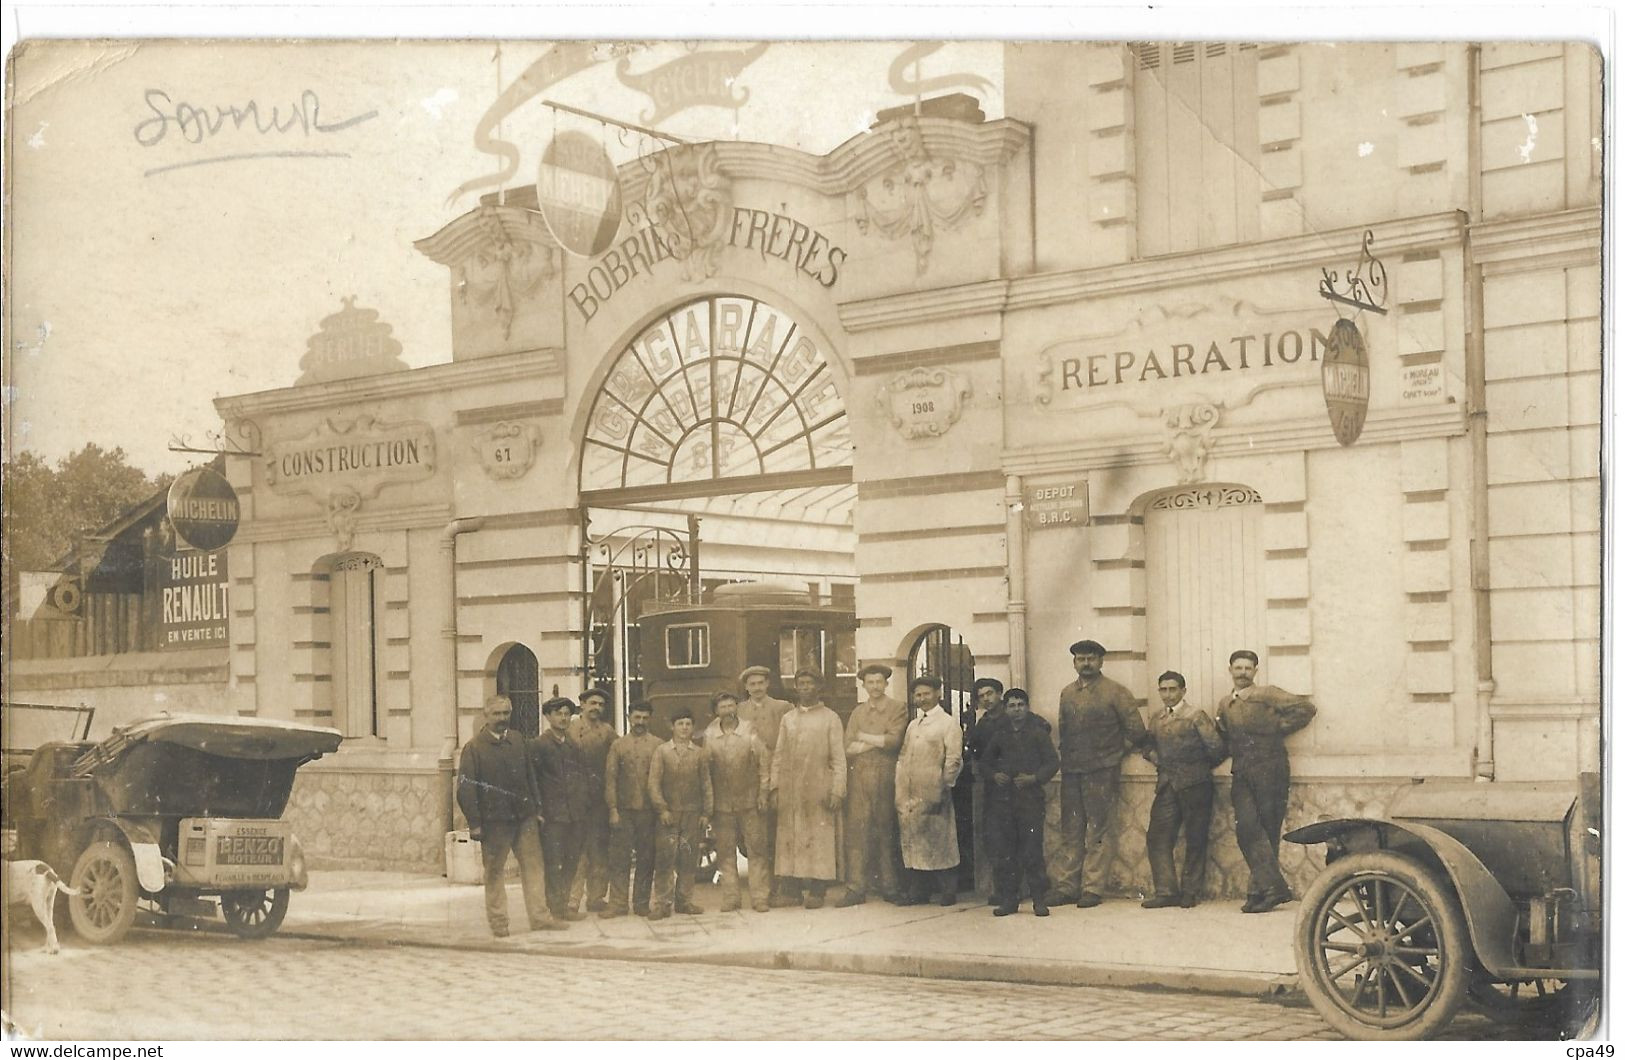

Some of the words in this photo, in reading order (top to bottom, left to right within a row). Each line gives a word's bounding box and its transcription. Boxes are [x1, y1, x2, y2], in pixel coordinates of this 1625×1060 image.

[642, 302, 842, 421] GARAGE
[639, 373, 777, 459] MODERNE
[911, 401, 935, 415] 1908
[282, 438, 420, 477] CONSTRUCTION
[495, 448, 512, 463] 67
[1036, 485, 1075, 500] DEPOT
[172, 498, 238, 521] MICHELIN
[171, 554, 218, 581] HUILE
[163, 582, 229, 624] RENAULT
[168, 631, 179, 643] EN
[181, 628, 212, 641] VENTE
[214, 626, 226, 639] ICI
[236, 827, 267, 835] ESSENCE
[218, 837, 279, 854] BENZO
[227, 854, 273, 864] MOTEUR
